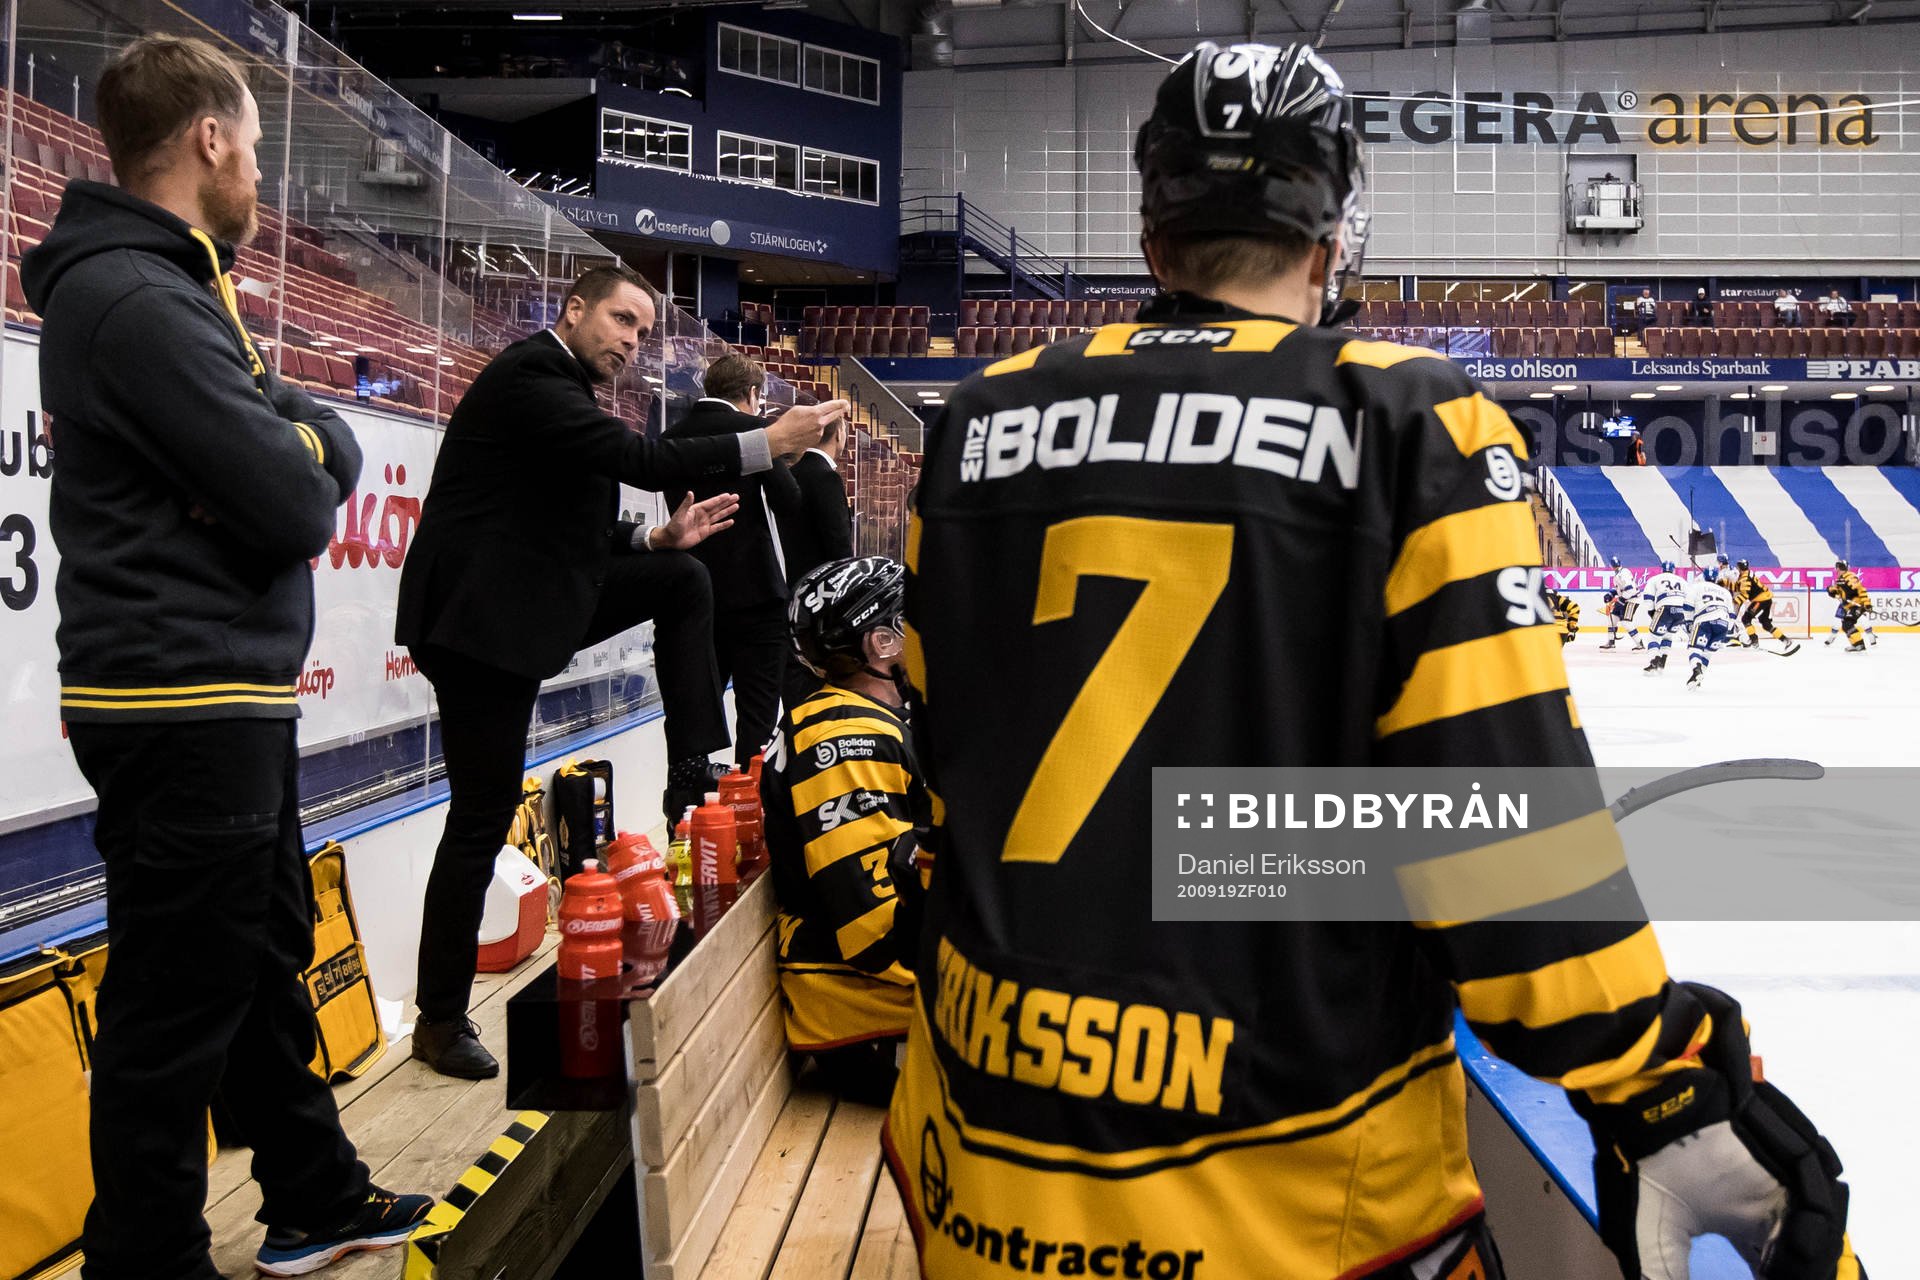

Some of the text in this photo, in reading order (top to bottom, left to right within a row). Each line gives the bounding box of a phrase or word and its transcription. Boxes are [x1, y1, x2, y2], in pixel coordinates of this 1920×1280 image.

[1222, 103, 1243, 130] 7
[1647, 92, 1880, 146] arena
[749, 231, 816, 253] STJÄRNLOGEN
[1129, 329, 1232, 346] CCM
[1465, 359, 1577, 378] clas ohlson
[1631, 360, 1771, 377] Leksands Sparbank
[1826, 360, 1920, 379] PEAB
[0, 410, 54, 479] ub
[960, 393, 1365, 490] NEW BOLIDEN
[852, 602, 879, 627] CCM
[1000, 515, 1235, 864] 7
[838, 738, 876, 748] Boliden
[839, 748, 874, 757] Electro
[944, 1190, 1204, 1280] ontractor
